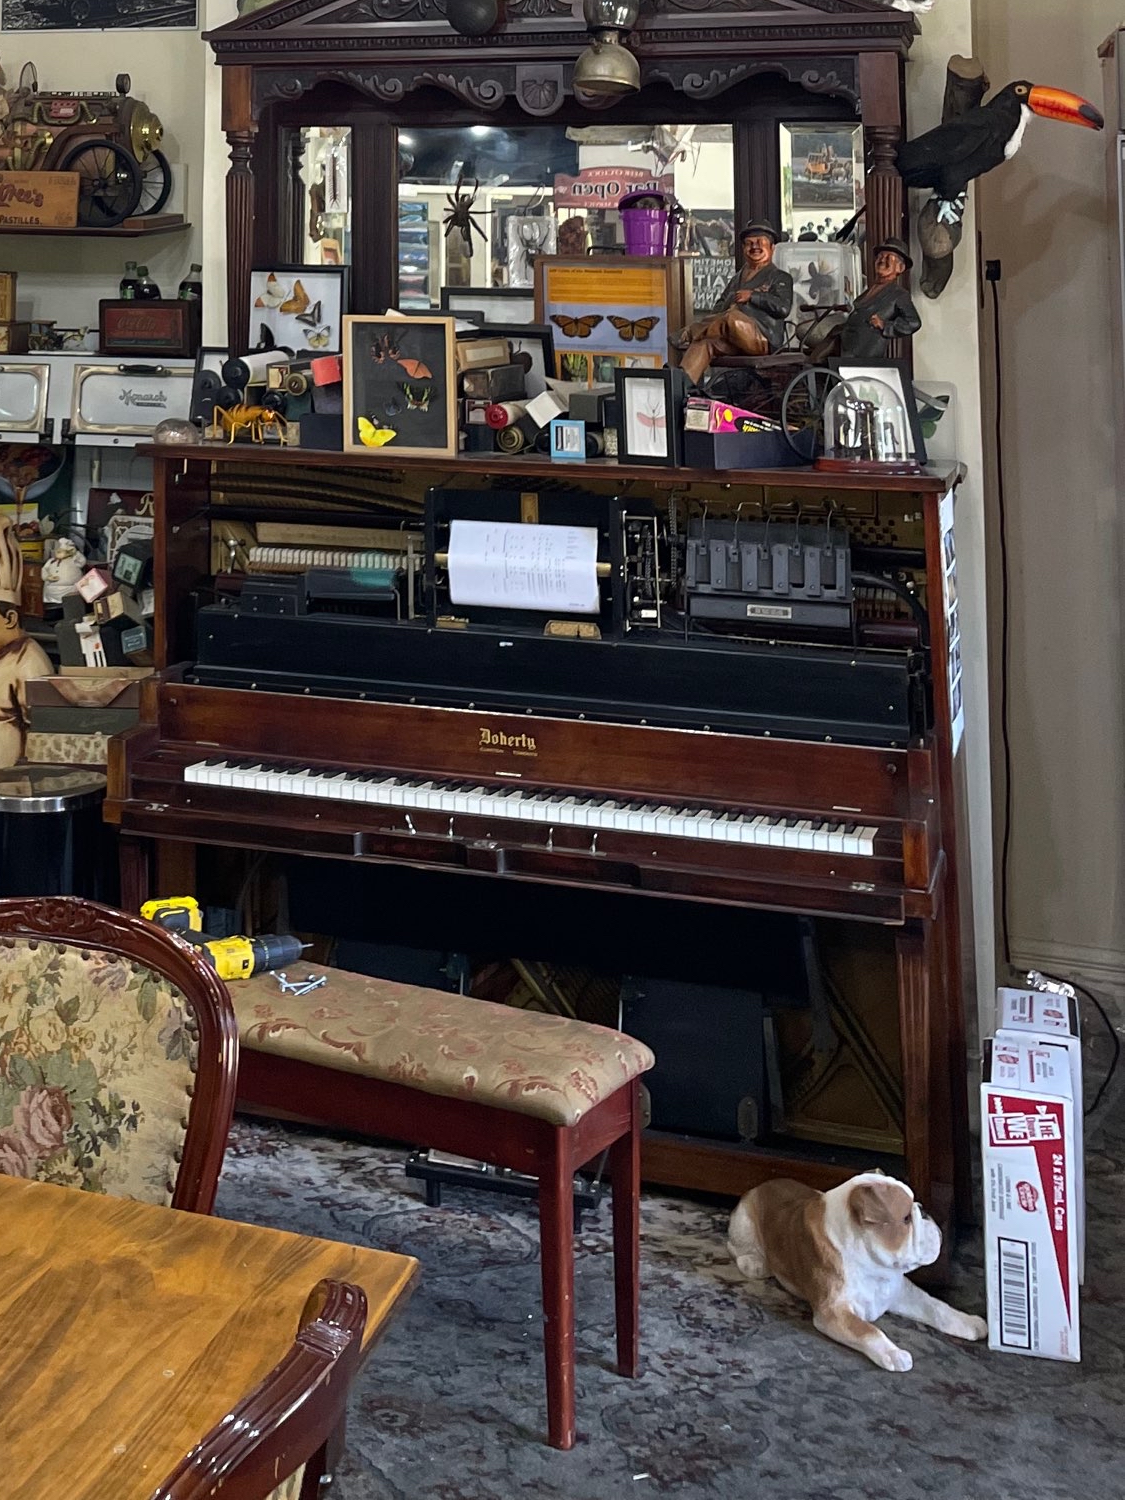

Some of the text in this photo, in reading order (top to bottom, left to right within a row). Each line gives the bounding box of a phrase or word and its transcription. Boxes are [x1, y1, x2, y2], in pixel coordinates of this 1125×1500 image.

[478, 727, 537, 750] Doherty
[1006, 1116, 1026, 1139] WE
[1038, 1116, 1057, 1139] THE
[1052, 1153, 1063, 1166] 24
[1053, 1206, 1065, 1231] Cans
